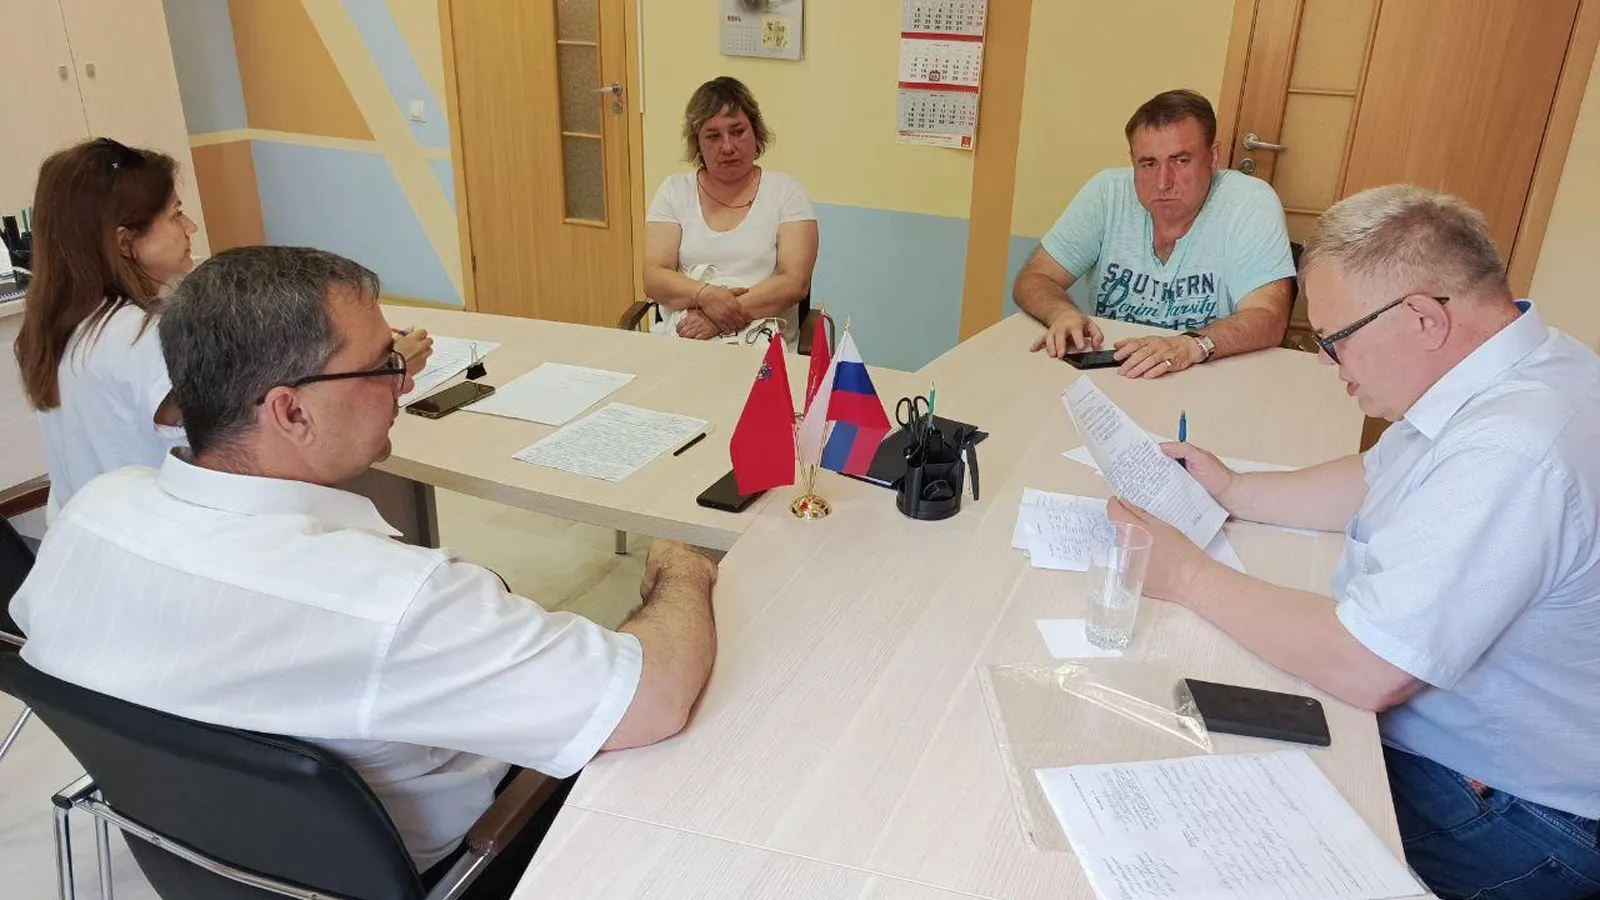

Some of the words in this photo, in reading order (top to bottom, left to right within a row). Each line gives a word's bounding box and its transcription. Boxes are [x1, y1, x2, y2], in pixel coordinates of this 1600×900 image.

[1101, 278, 1159, 317] Denim
[1164, 292, 1217, 318] Varsity
[1103, 263, 1215, 302] SOUTHERN
